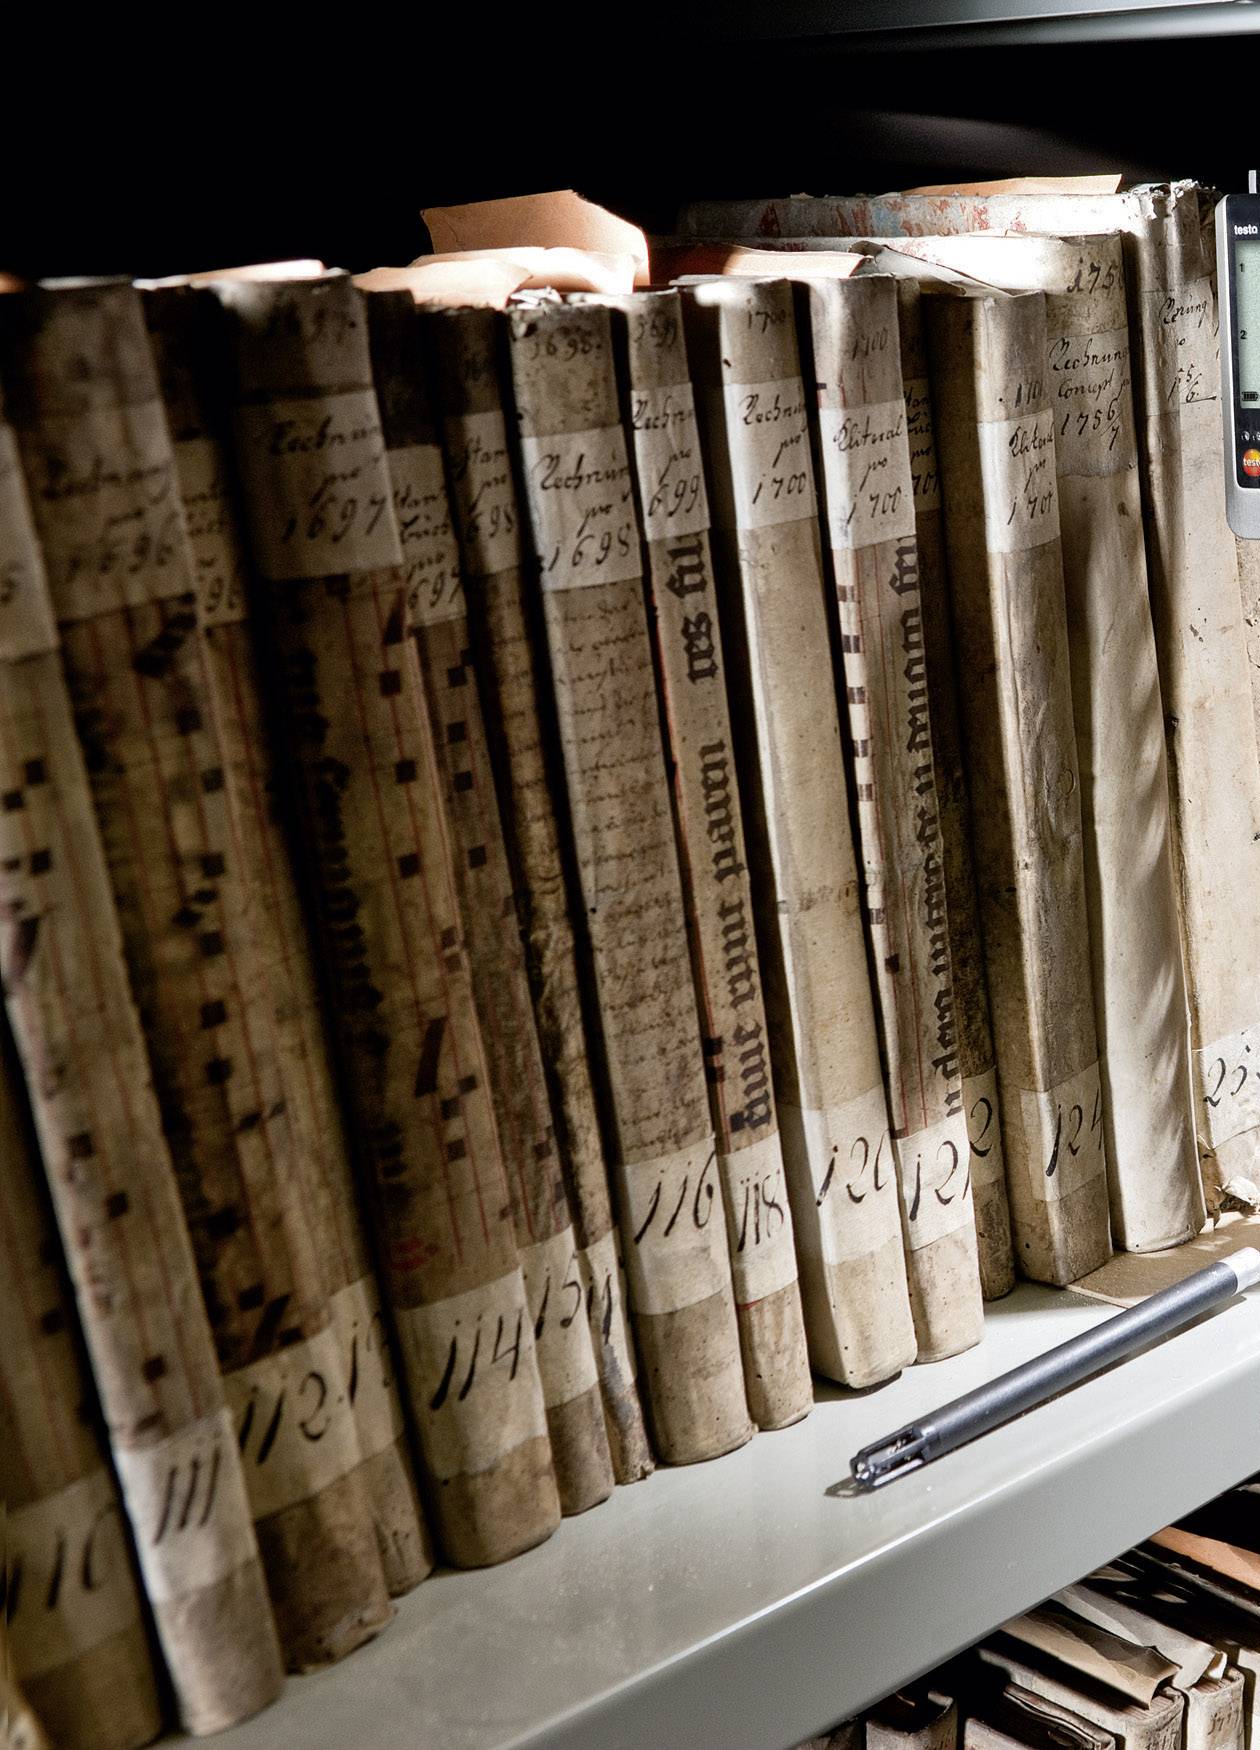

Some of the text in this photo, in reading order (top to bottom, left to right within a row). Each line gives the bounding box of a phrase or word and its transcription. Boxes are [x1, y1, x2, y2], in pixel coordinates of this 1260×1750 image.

[1234, 224, 1258, 235] testo
[1240, 330, 1248, 340] 2
[549, 521, 632, 572] 1698
[430, 1309, 523, 1411] 114
